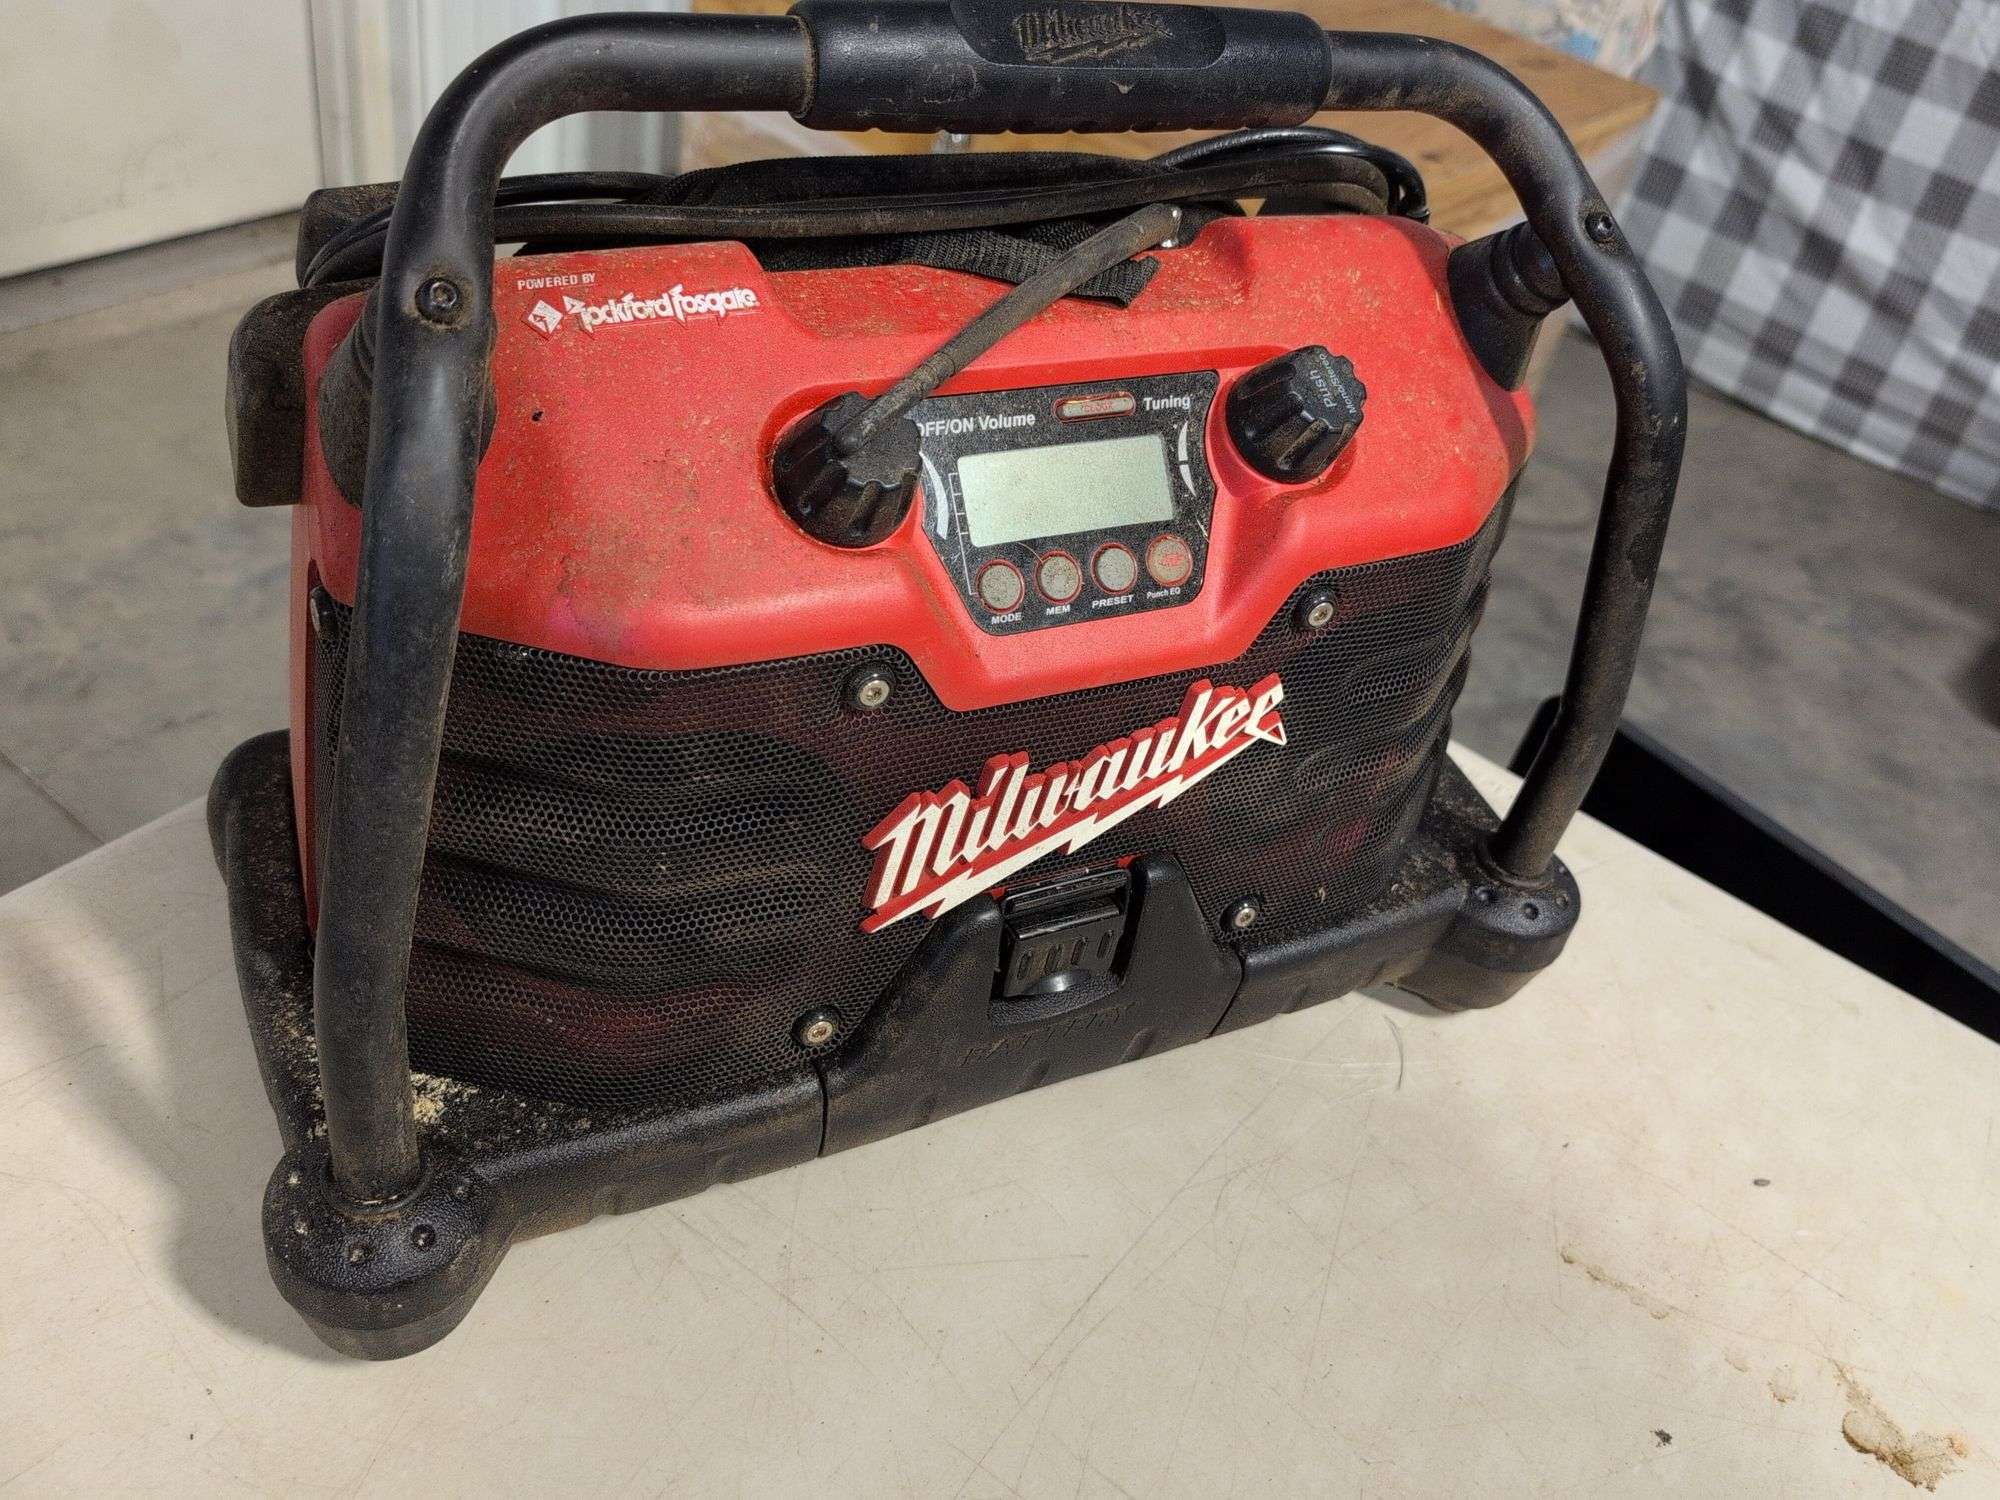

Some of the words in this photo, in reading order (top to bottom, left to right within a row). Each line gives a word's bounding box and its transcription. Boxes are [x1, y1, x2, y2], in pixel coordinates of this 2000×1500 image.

[517, 275, 578, 290] POWERED
[581, 272, 596, 284] BY
[1309, 369, 1338, 408] Push
[1143, 393, 1191, 411] Tuning
[978, 413, 1036, 431] Volume
[1091, 594, 1134, 610] PRESET
[1146, 589, 1169, 599] Punch
[991, 611, 1022, 625] MODE
[1046, 604, 1071, 616] MEM
[860, 672, 1288, 928] Milwaukee
